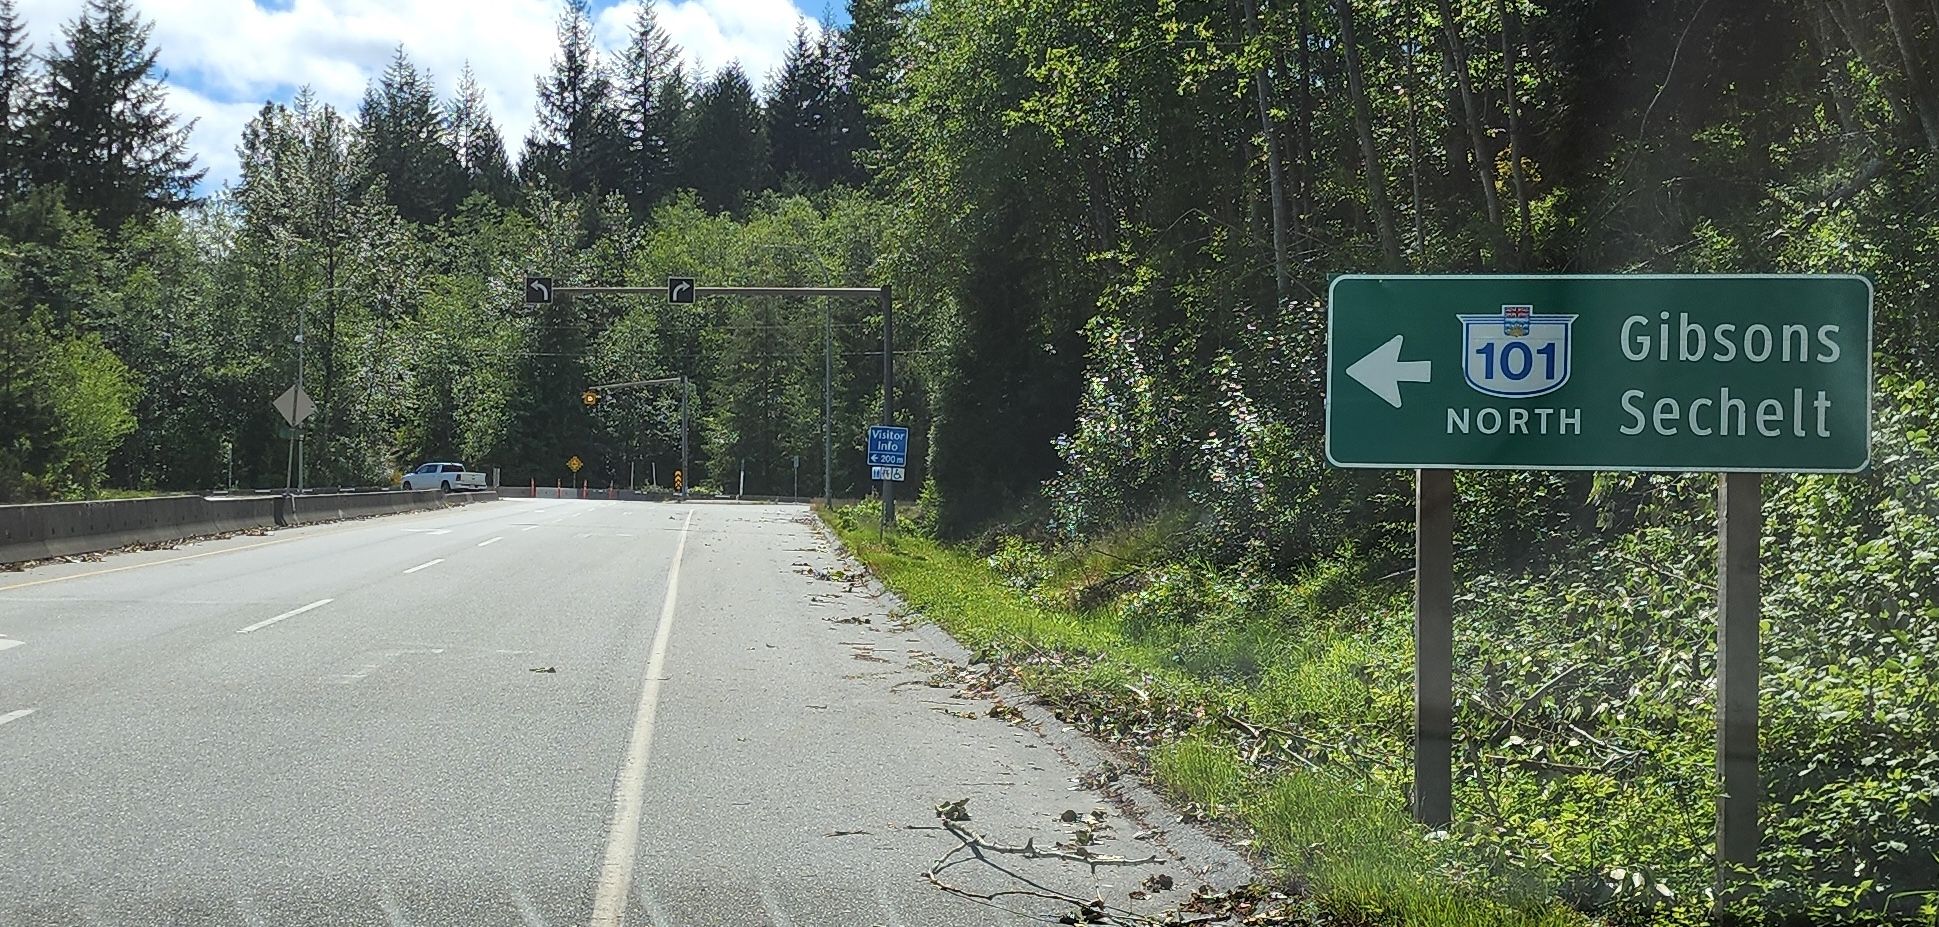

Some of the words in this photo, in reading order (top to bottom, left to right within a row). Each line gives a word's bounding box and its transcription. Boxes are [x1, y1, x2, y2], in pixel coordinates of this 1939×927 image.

[1620, 312, 1841, 363] Gibsons
[1475, 341, 1556, 381] 101
[1446, 408, 1582, 435] NORTH
[1620, 387, 1832, 438] Sechelt
[871, 429, 905, 440] Visitor
[877, 441, 898, 451] Info
[880, 454, 896, 463] 200
